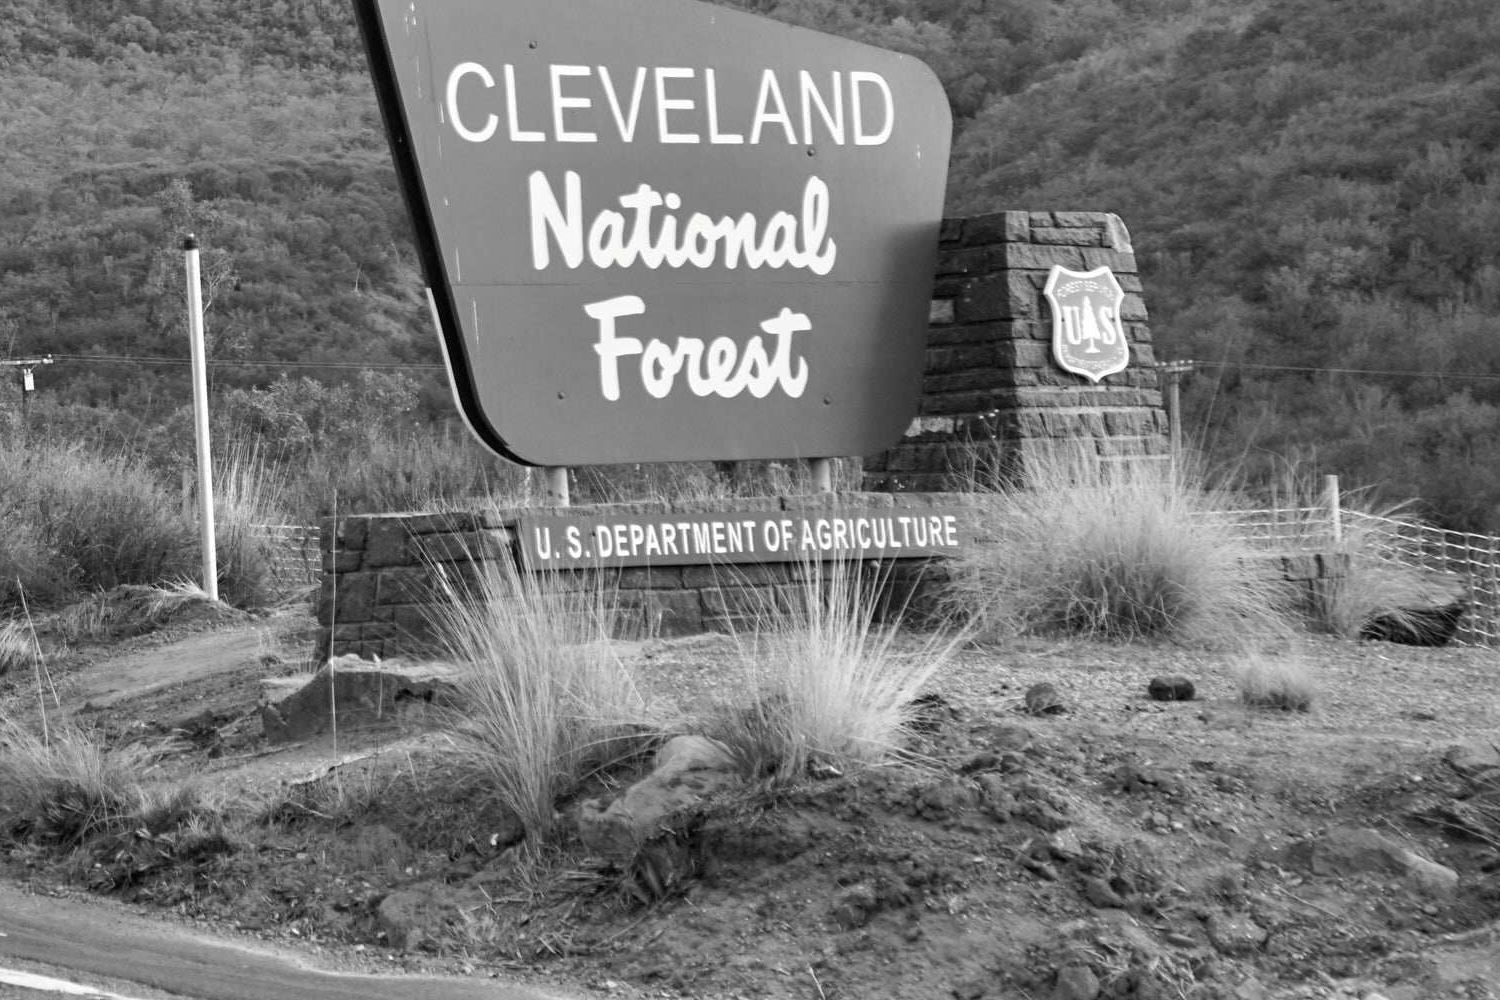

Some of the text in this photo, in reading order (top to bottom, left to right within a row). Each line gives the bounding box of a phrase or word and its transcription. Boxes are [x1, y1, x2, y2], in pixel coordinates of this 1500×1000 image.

[445, 61, 895, 146] CLEVELAND
[528, 169, 837, 276] National
[583, 294, 813, 401] Forest
[597, 520, 756, 558] DEPARTMENT
[763, 519, 793, 552] OF
[801, 515, 959, 551] AGRICULTURE
